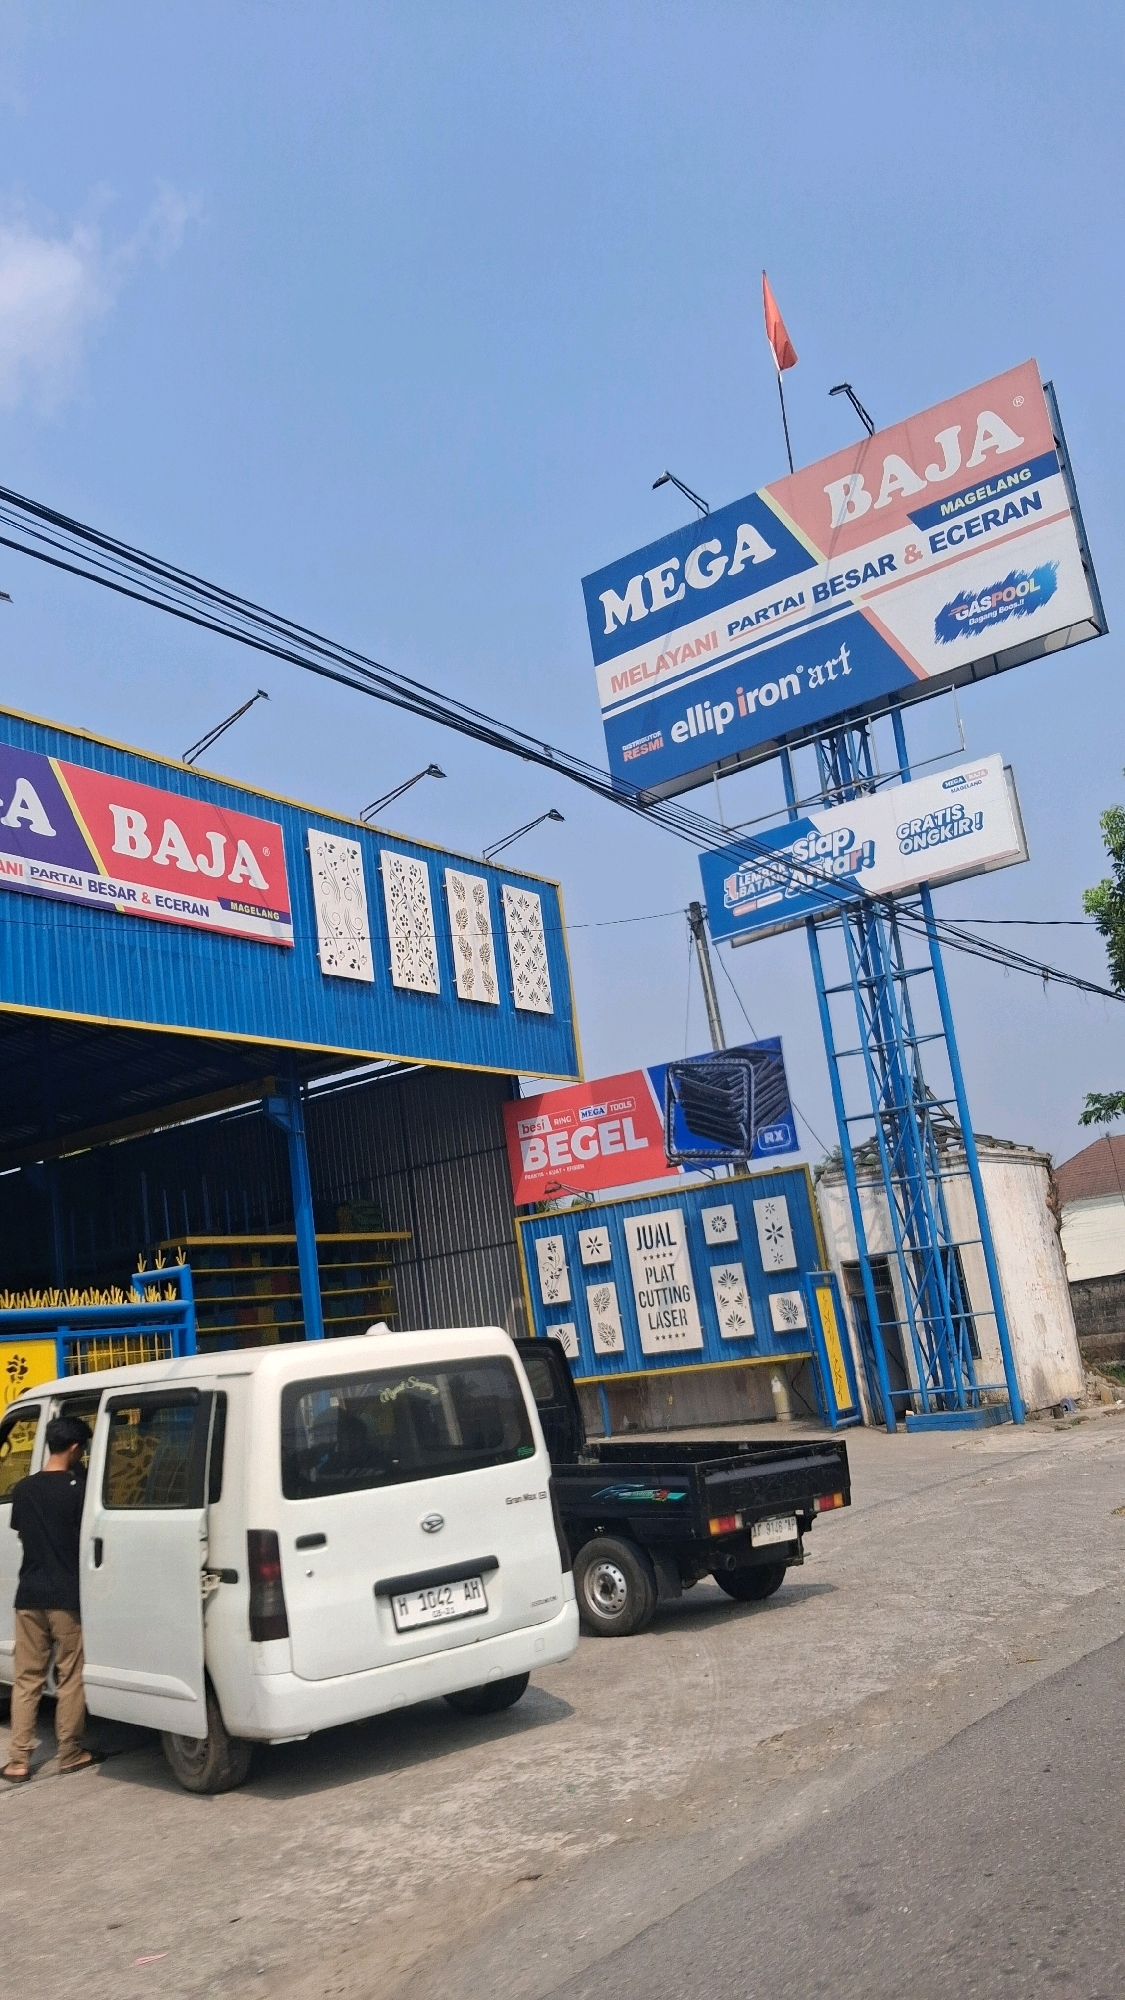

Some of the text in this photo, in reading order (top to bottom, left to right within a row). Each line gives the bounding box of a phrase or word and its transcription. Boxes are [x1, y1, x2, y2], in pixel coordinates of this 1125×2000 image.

[940, 468, 1032, 517] MAGELANG
[599, 410, 1025, 634] MEGA BAJA
[610, 490, 1043, 694] MELAYANI PARTAI BESAR & ECERAN
[949, 577, 1041, 621] GASPOOL
[969, 609, 997, 626] Dagang
[670, 641, 853, 744] ellip iron art
[622, 730, 662, 751] DISTRIBUTOR
[623, 736, 665, 763] RESMI
[896, 803, 965, 840] GRATIS
[108, 803, 270, 890] BAJA
[30, 865, 83, 886] PARTAI
[87, 879, 137, 901] BESAR
[141, 891, 152, 905] &
[155, 894, 210, 917] ECERAN
[230, 901, 280, 920] MAGELANG
[581, 1100, 633, 1119] MEGA TOOLS
[522, 1115, 572, 1135] besi RING
[764, 1129, 784, 1144] RX
[520, 1116, 649, 1172] BEGEL
[636, 1221, 677, 1251] JUAL
[645, 1263, 676, 1285] PLAT
[638, 1284, 691, 1308] CUTTING
[648, 1308, 689, 1331] LASER
[397, 1580, 481, 1616] H 1042 AH
